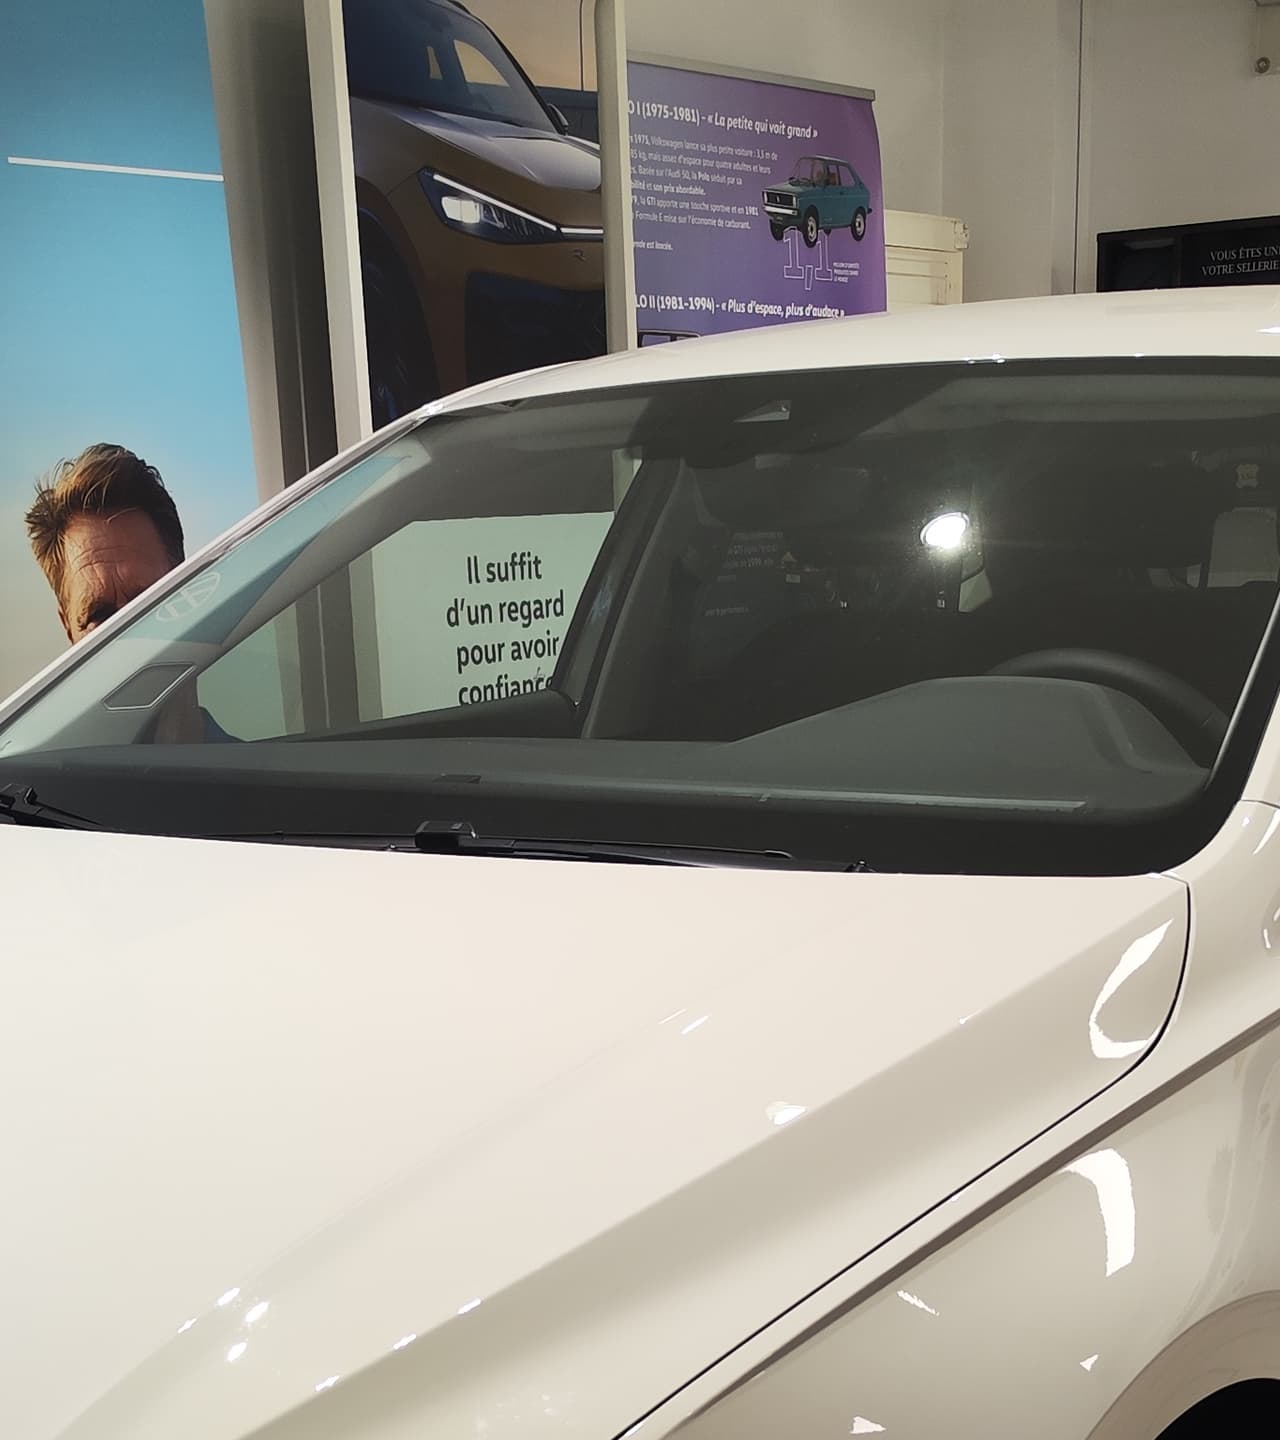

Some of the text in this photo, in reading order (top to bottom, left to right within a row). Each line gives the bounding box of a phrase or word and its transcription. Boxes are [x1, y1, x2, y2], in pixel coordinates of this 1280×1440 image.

[641, 102, 700, 127] (1975-1981)
[714, 112, 725, 126] La
[726, 115, 753, 131] petite
[754, 119, 768, 135] qui
[769, 121, 786, 135] voit
[786, 125, 812, 139] grand
[1201, 262, 1235, 276] VOTRE
[1235, 259, 1280, 273] SELLERIE
[1210, 248, 1237, 261] VOUS
[1239, 246, 1263, 260] ÊTES
[656, 296, 715, 314] (1981-1994)
[728, 299, 746, 313] Plus
[747, 300, 784, 318] d'espace,
[785, 302, 804, 318] plus
[466, 551, 543, 585] Il suffit
[446, 589, 565, 628] d'un regard
[456, 630, 561, 674] pour avoir
